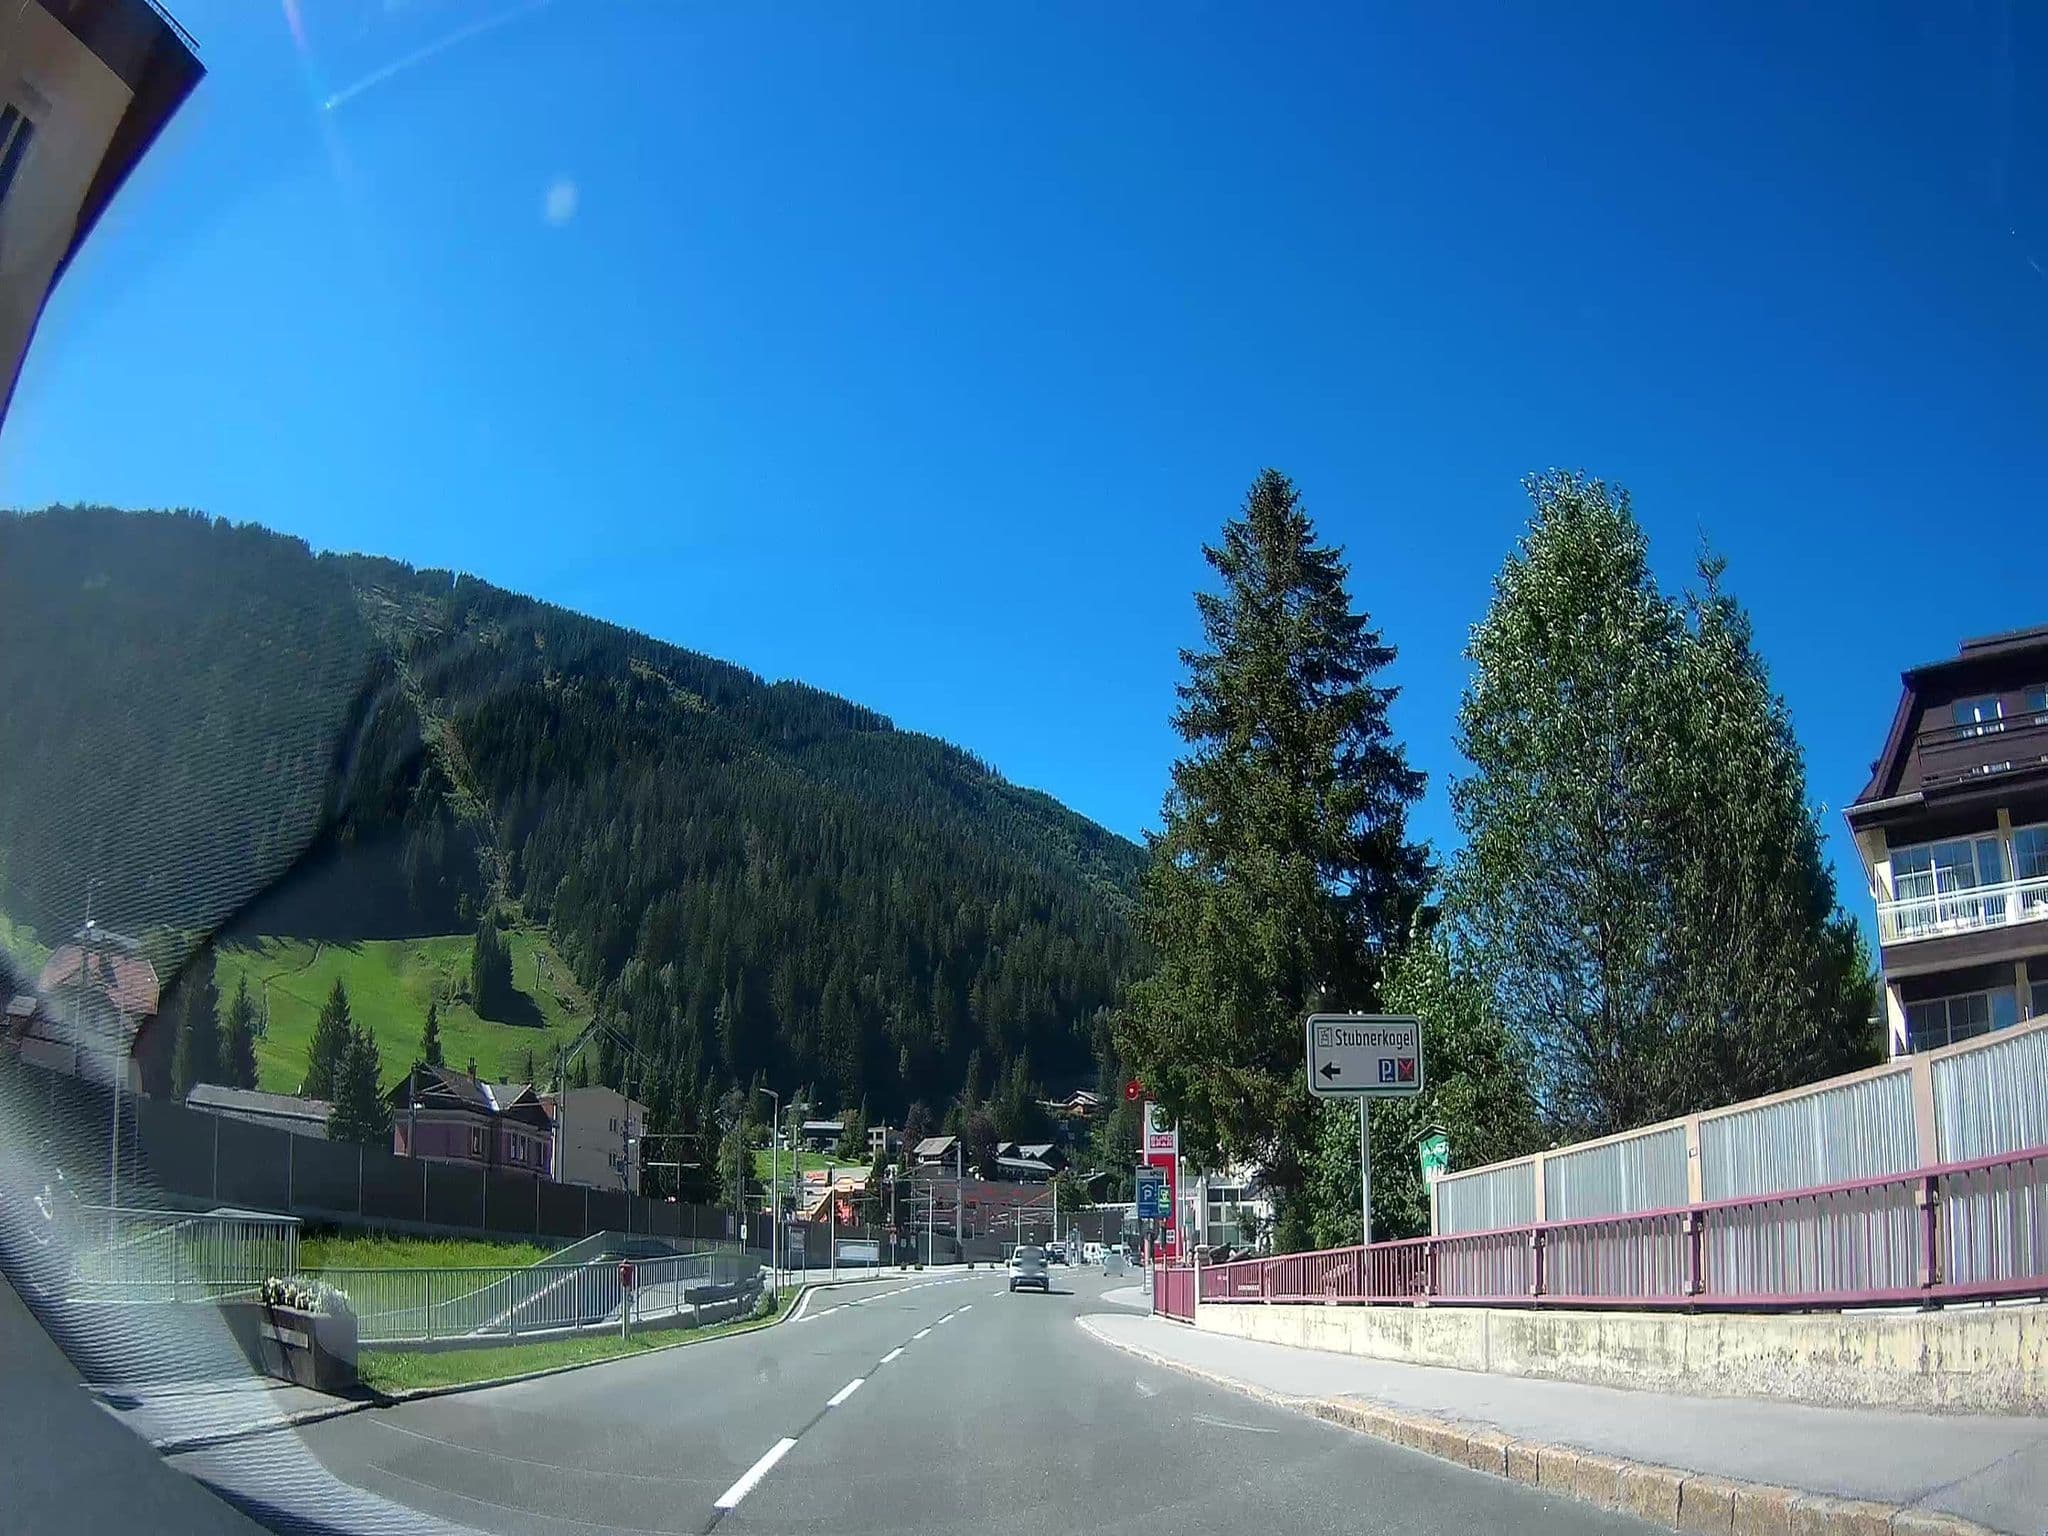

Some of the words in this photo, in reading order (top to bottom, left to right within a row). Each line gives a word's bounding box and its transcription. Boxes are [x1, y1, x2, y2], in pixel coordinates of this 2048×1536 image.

[1335, 1028, 1414, 1049] Stubnerkogel
[1381, 1060, 1392, 1081] P
[1143, 1189, 1153, 1200] P
